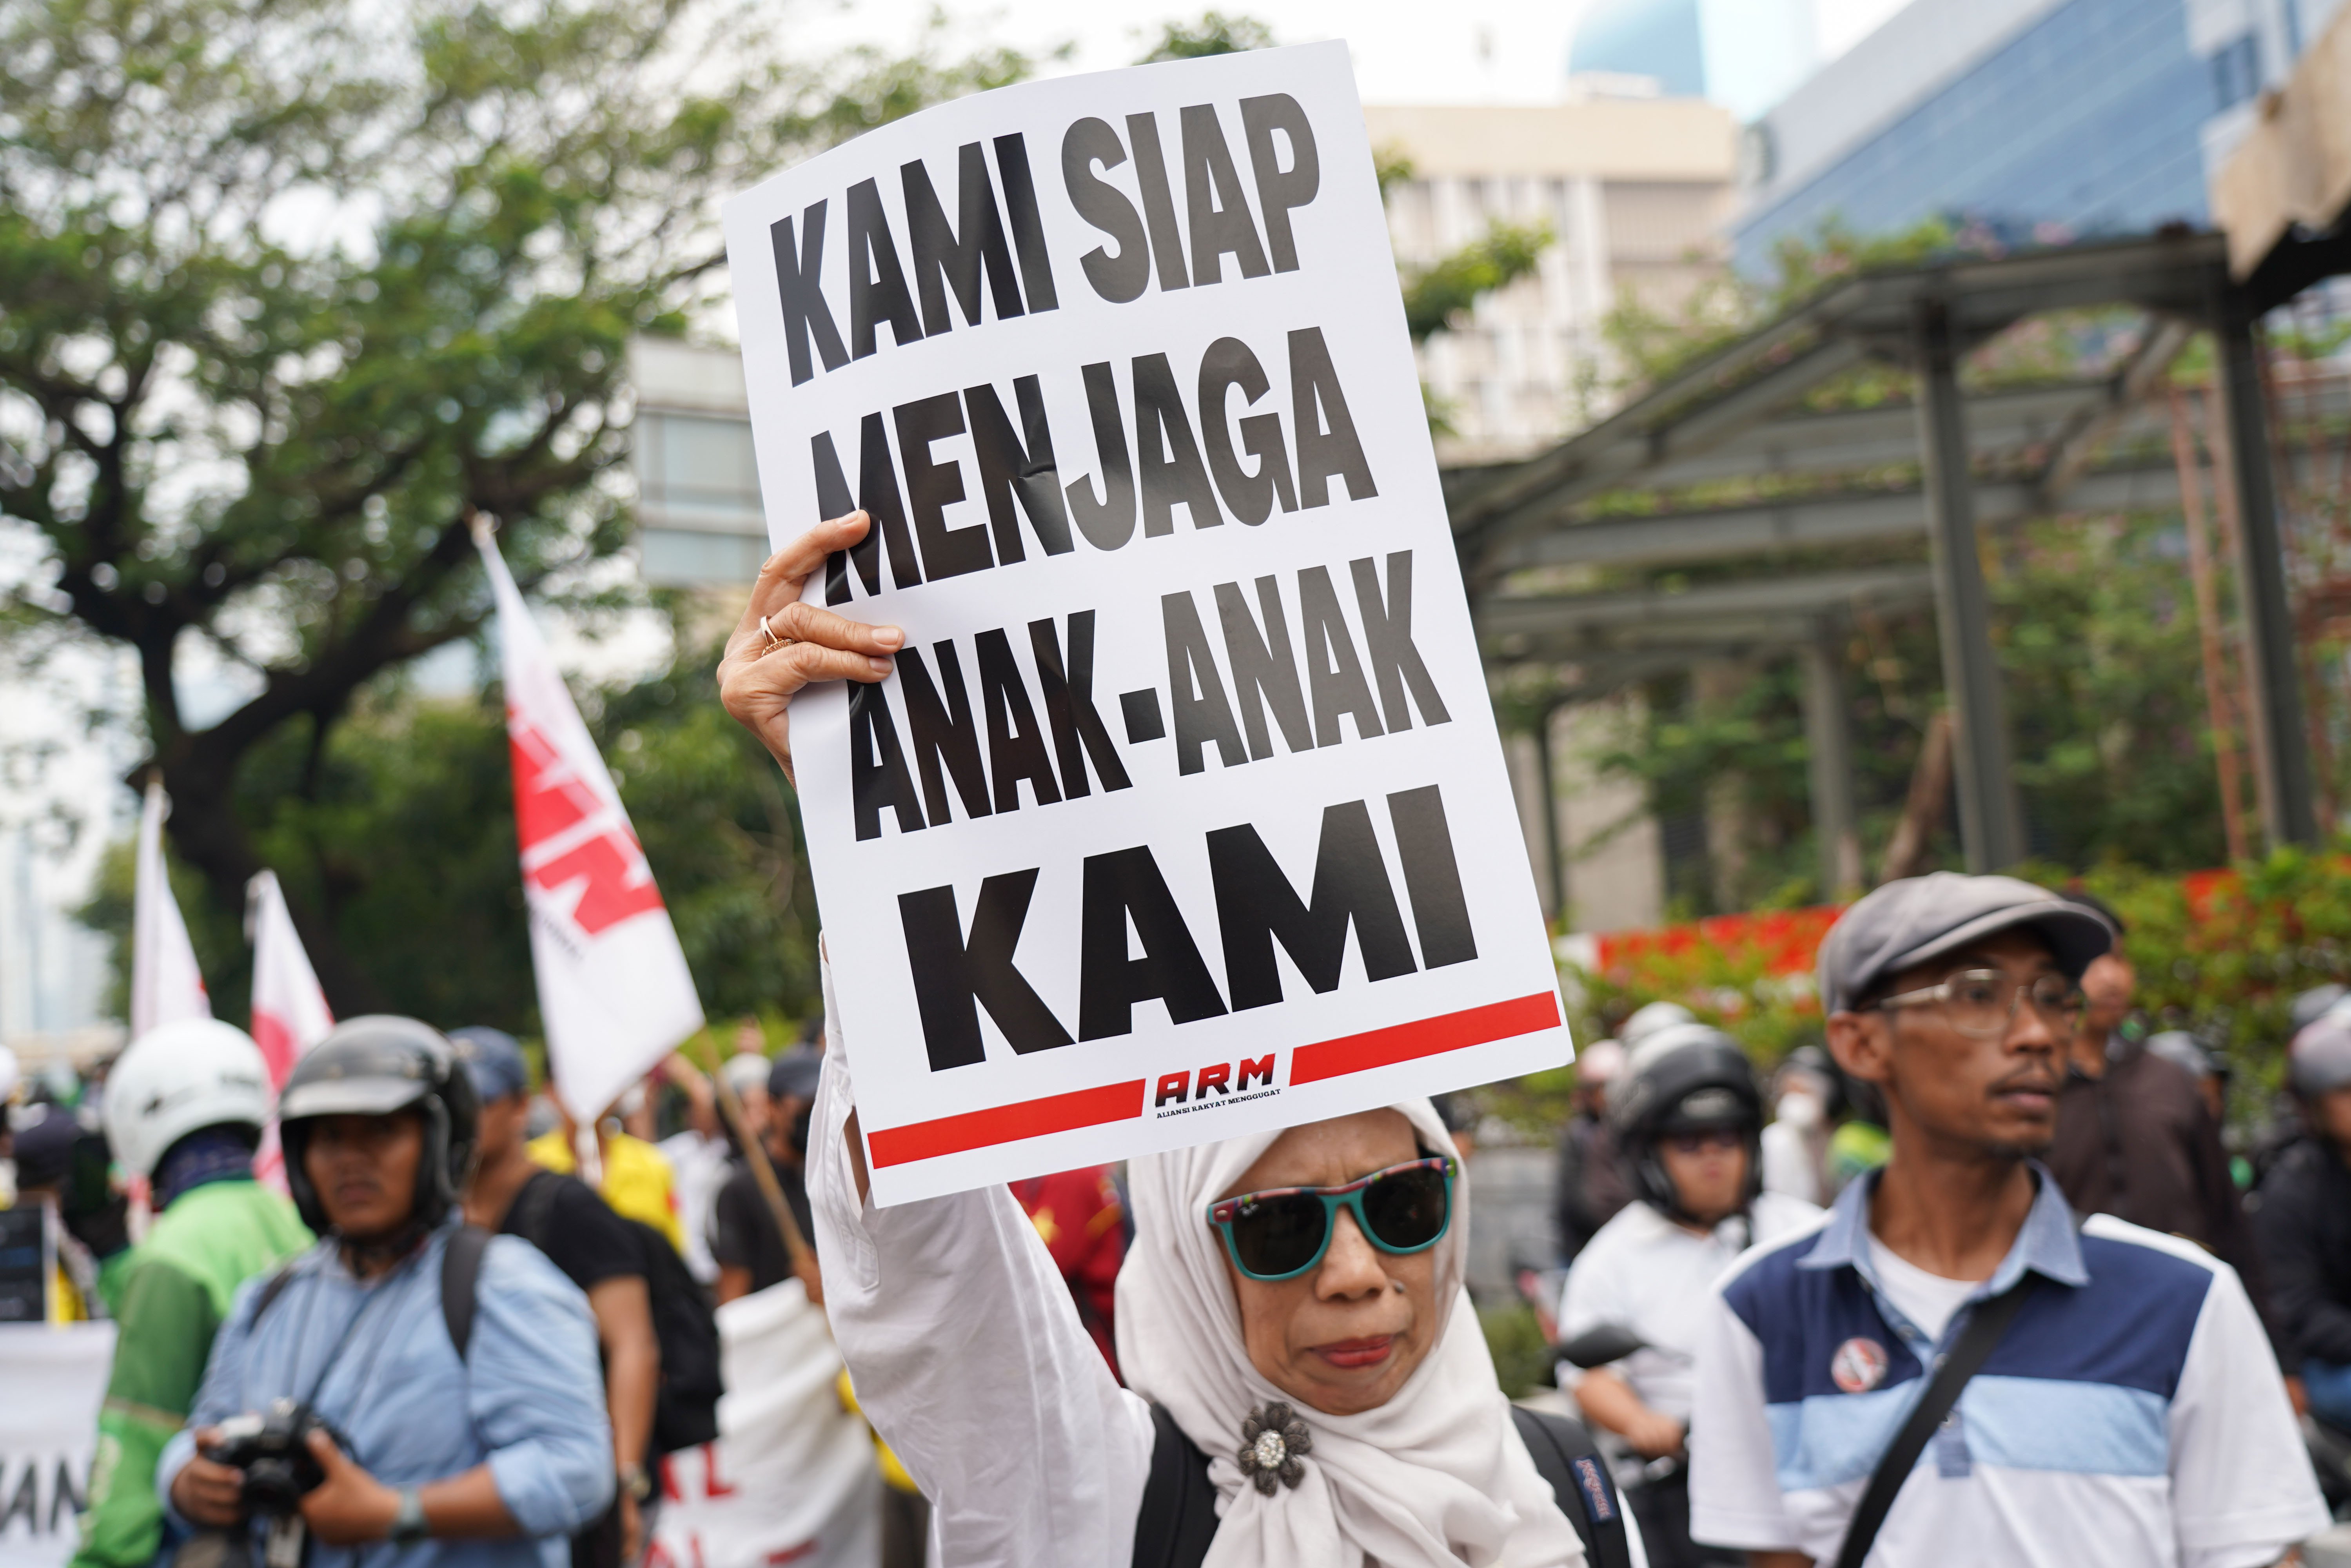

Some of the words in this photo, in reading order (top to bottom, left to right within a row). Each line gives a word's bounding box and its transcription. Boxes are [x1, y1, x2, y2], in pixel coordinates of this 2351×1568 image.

[770, 132, 1059, 387] KAMI
[1062, 93, 1320, 303] SIAP
[811, 327, 1379, 607] MENJAGA
[846, 550, 1452, 842] ANAK-ANAK
[897, 784, 1478, 1073] KAMI
[1155, 1053, 1276, 1108] ARM
[1156, 1107, 1190, 1119] ALIANSI
[1192, 1100, 1226, 1112] RAKYAT
[1228, 1089, 1281, 1105] MENGGUGAT
